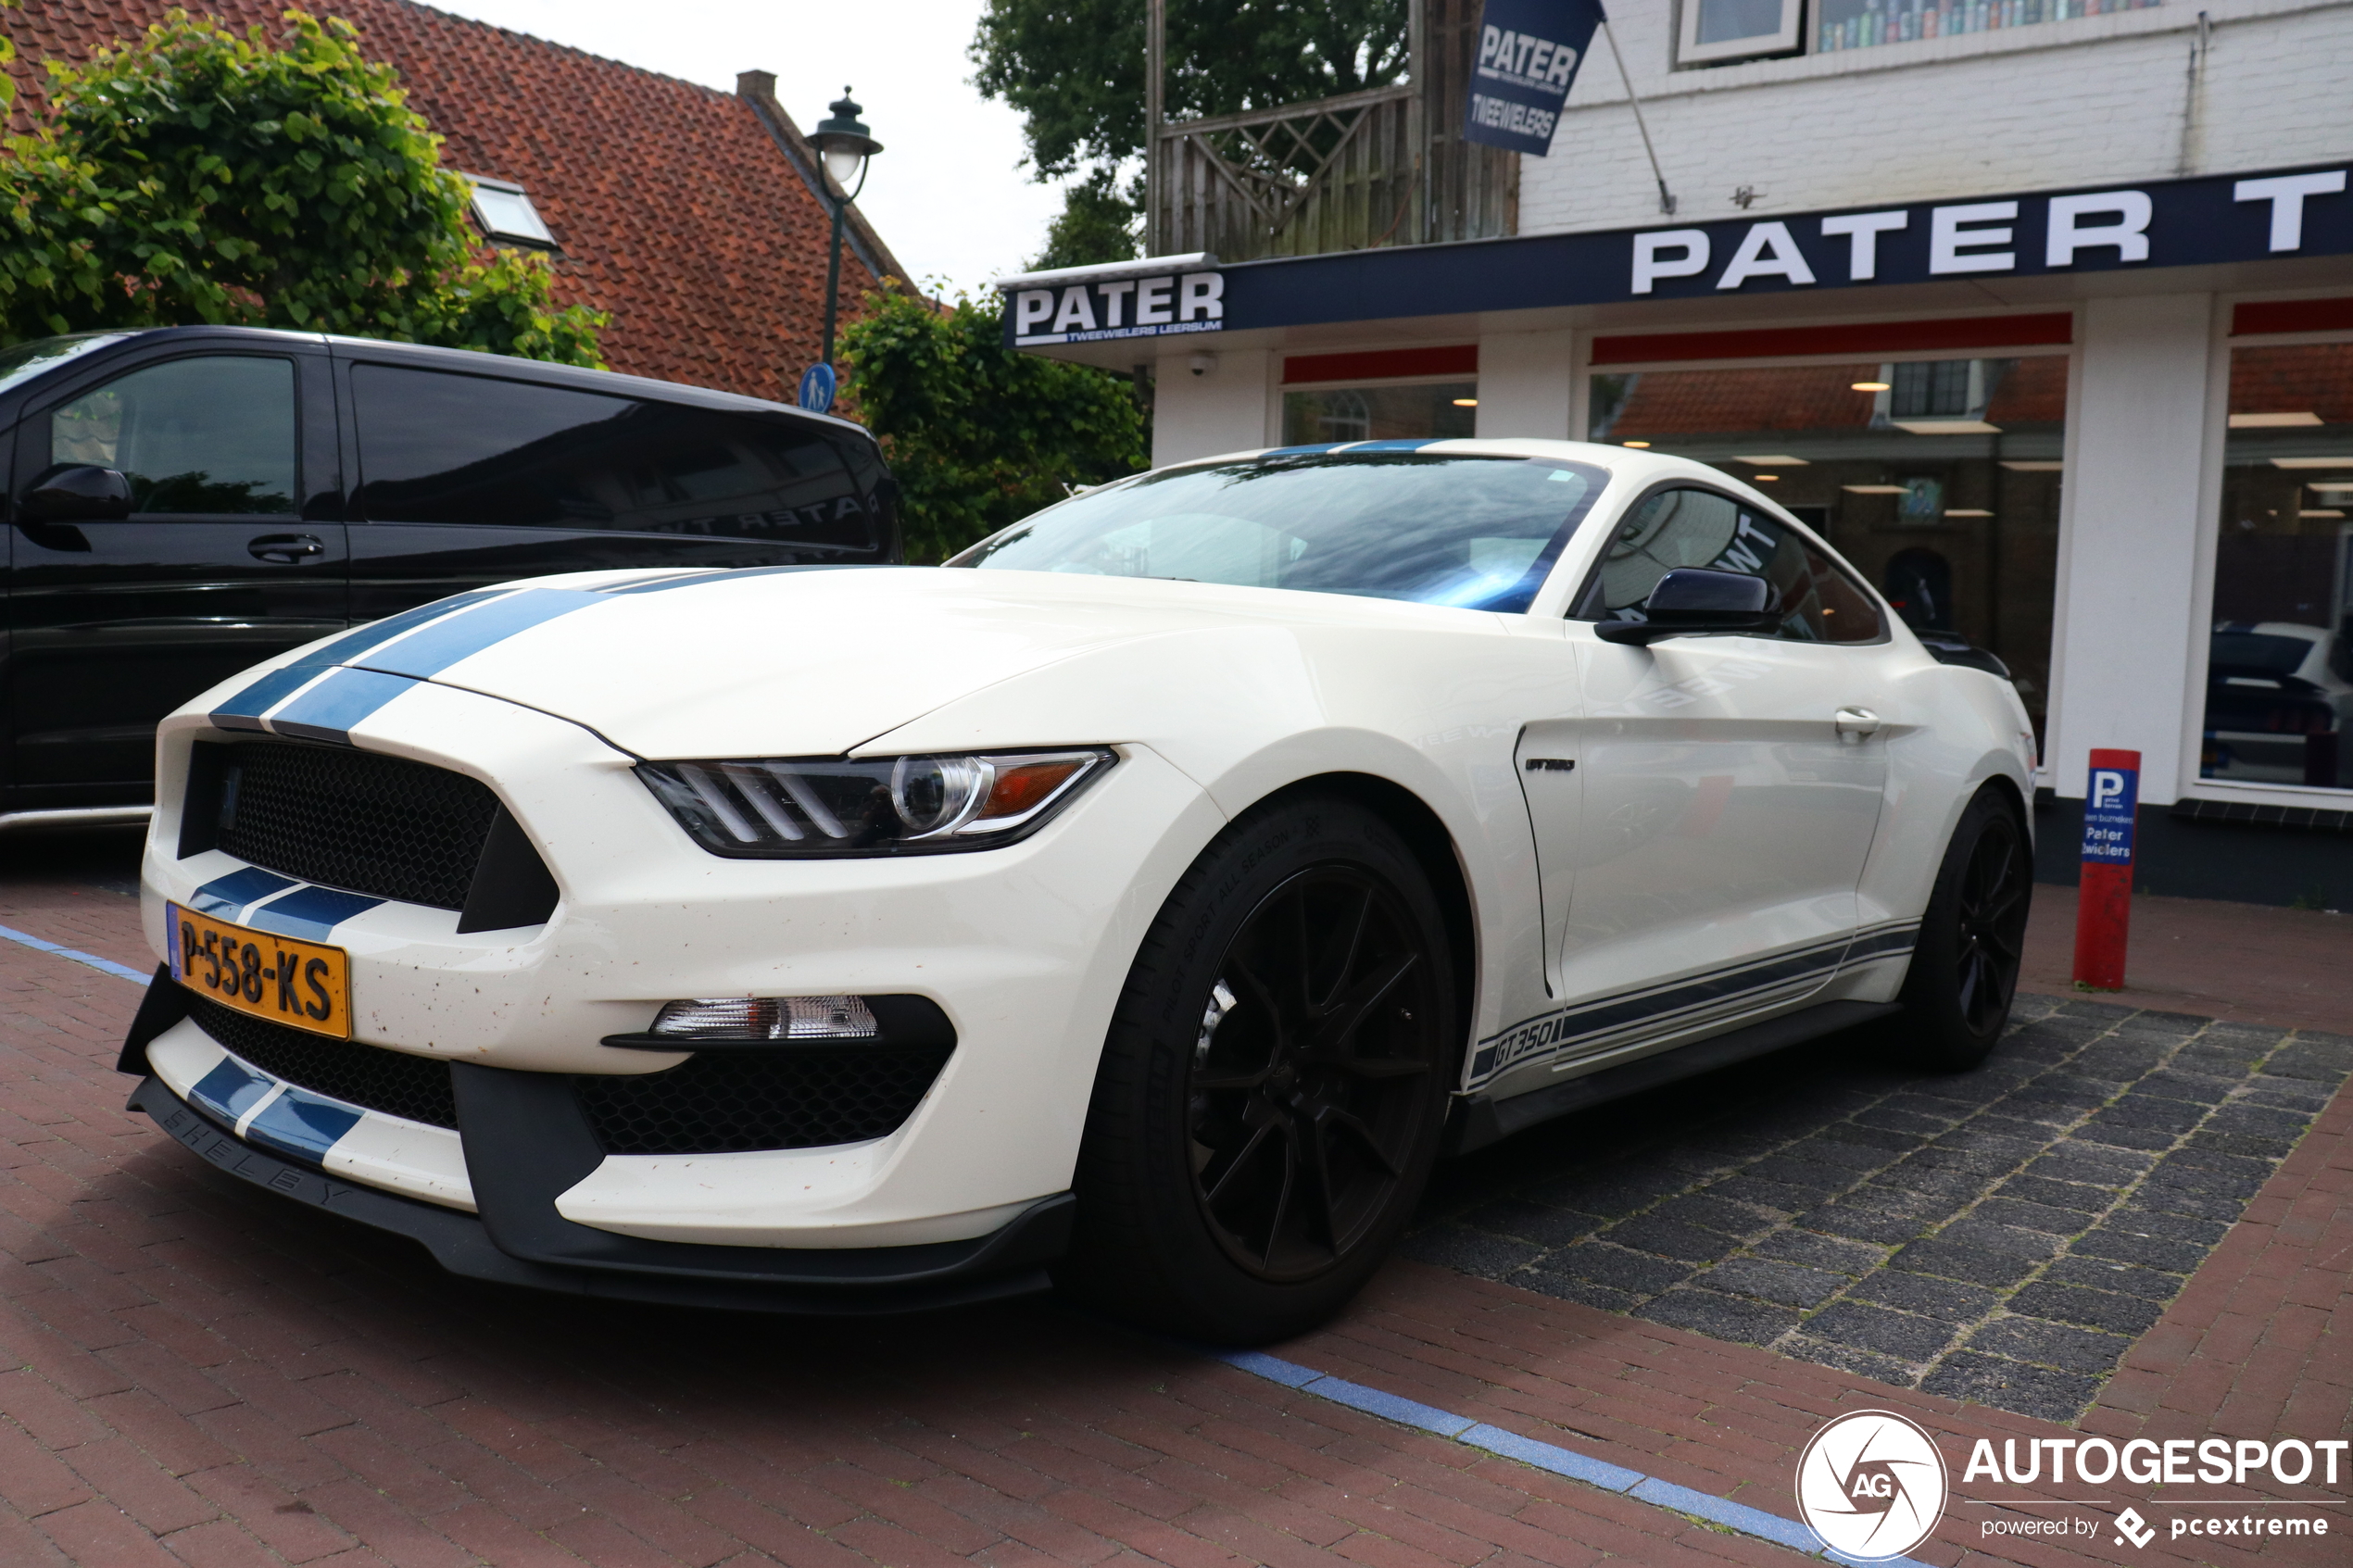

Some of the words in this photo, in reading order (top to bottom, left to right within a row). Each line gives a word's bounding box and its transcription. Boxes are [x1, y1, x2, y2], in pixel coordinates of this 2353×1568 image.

[1479, 24, 1578, 86] PATER
[1471, 94, 1555, 139] TWEEWIELERS
[1631, 190, 2154, 295] PATER
[2233, 169, 2347, 253] T
[1016, 272, 1225, 335] PATER
[1068, 325, 1157, 343] TWEEWIELERS
[1160, 320, 1222, 335] LEERSUM
[2093, 771, 2124, 809] P
[2085, 827, 2124, 841] Pater
[1163, 965, 1187, 1023] PILOT
[1183, 901, 1217, 963] SPORT
[1217, 872, 1241, 904] ALL
[1240, 828, 1290, 875] SEASON
[182, 921, 331, 1022] P-558-KS
[163, 1110, 354, 1206] SHELBY
